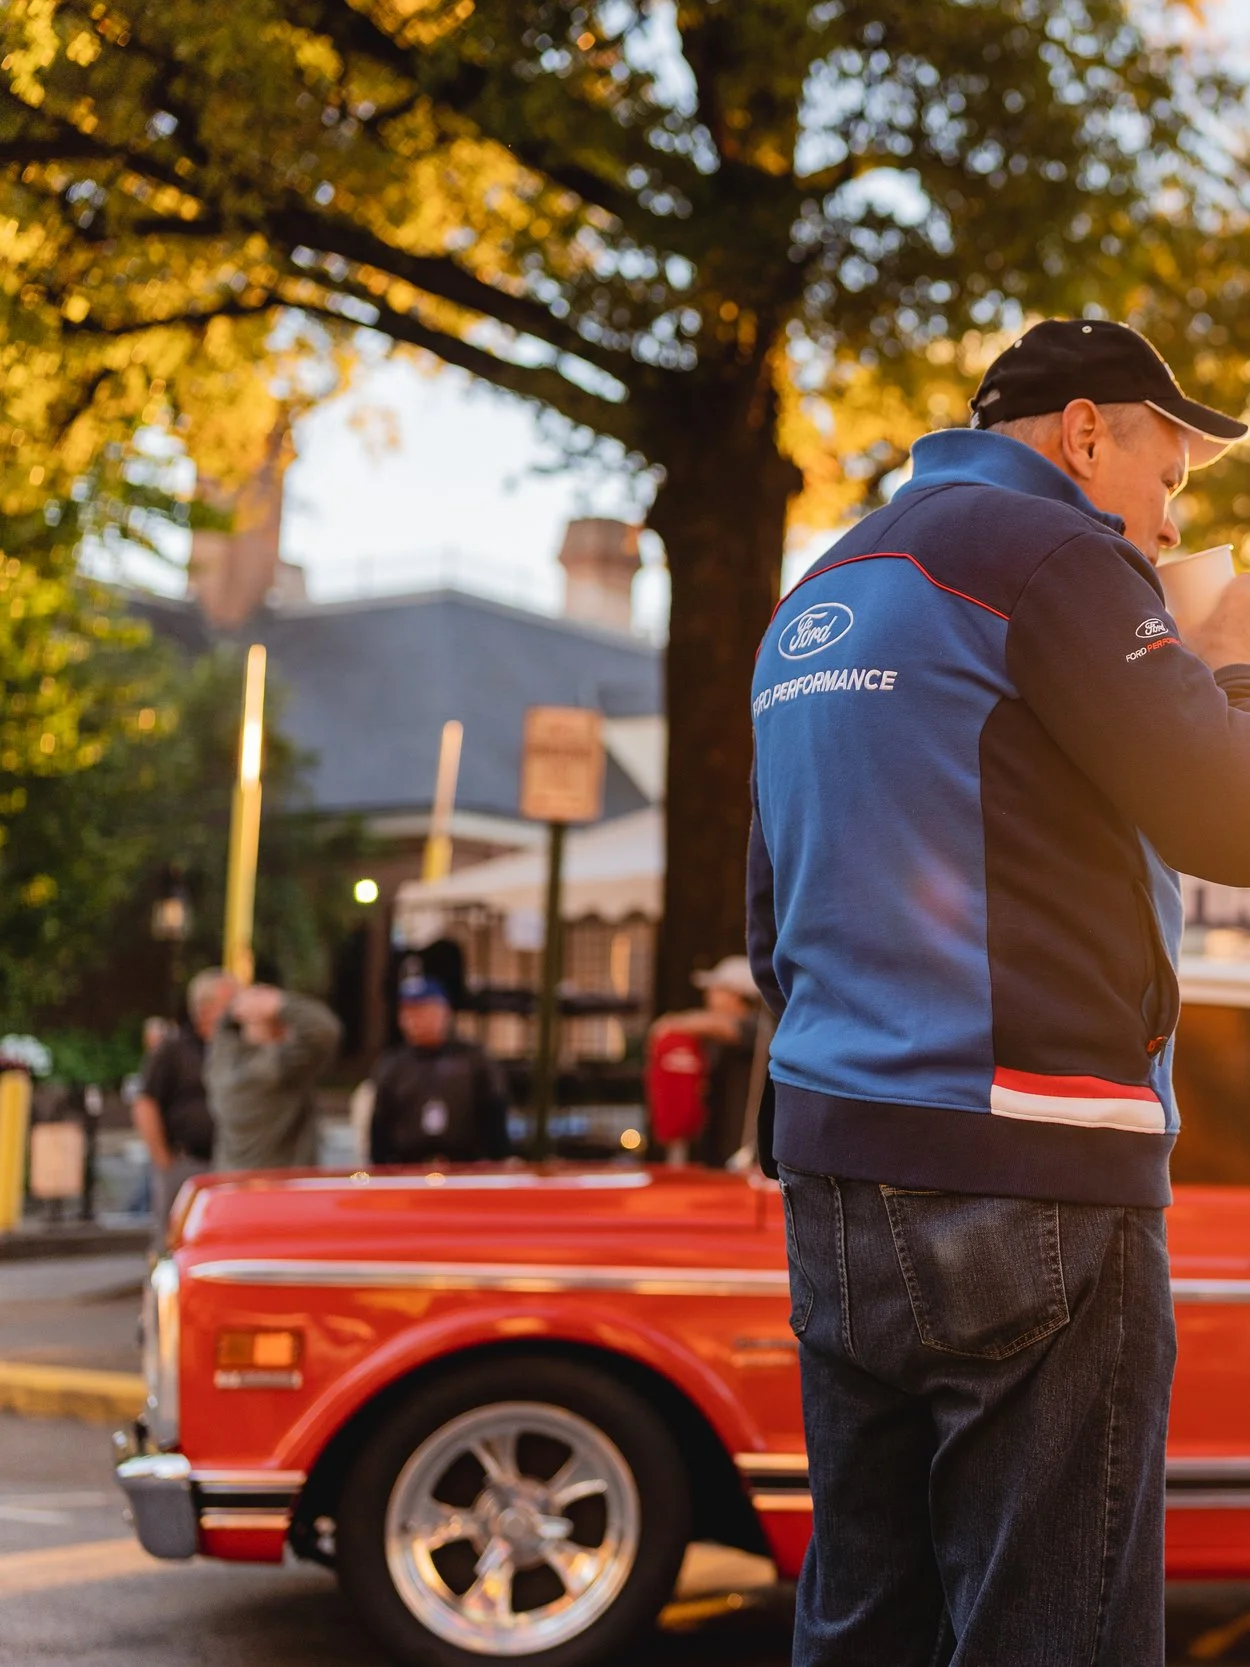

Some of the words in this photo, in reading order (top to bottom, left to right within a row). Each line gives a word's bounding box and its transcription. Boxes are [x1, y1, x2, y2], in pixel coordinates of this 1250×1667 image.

[789, 611, 838, 652] Ford
[1145, 621, 1166, 635] Ford
[1126, 647, 1147, 662] FORD
[771, 668, 898, 706] PERFORMANCE
